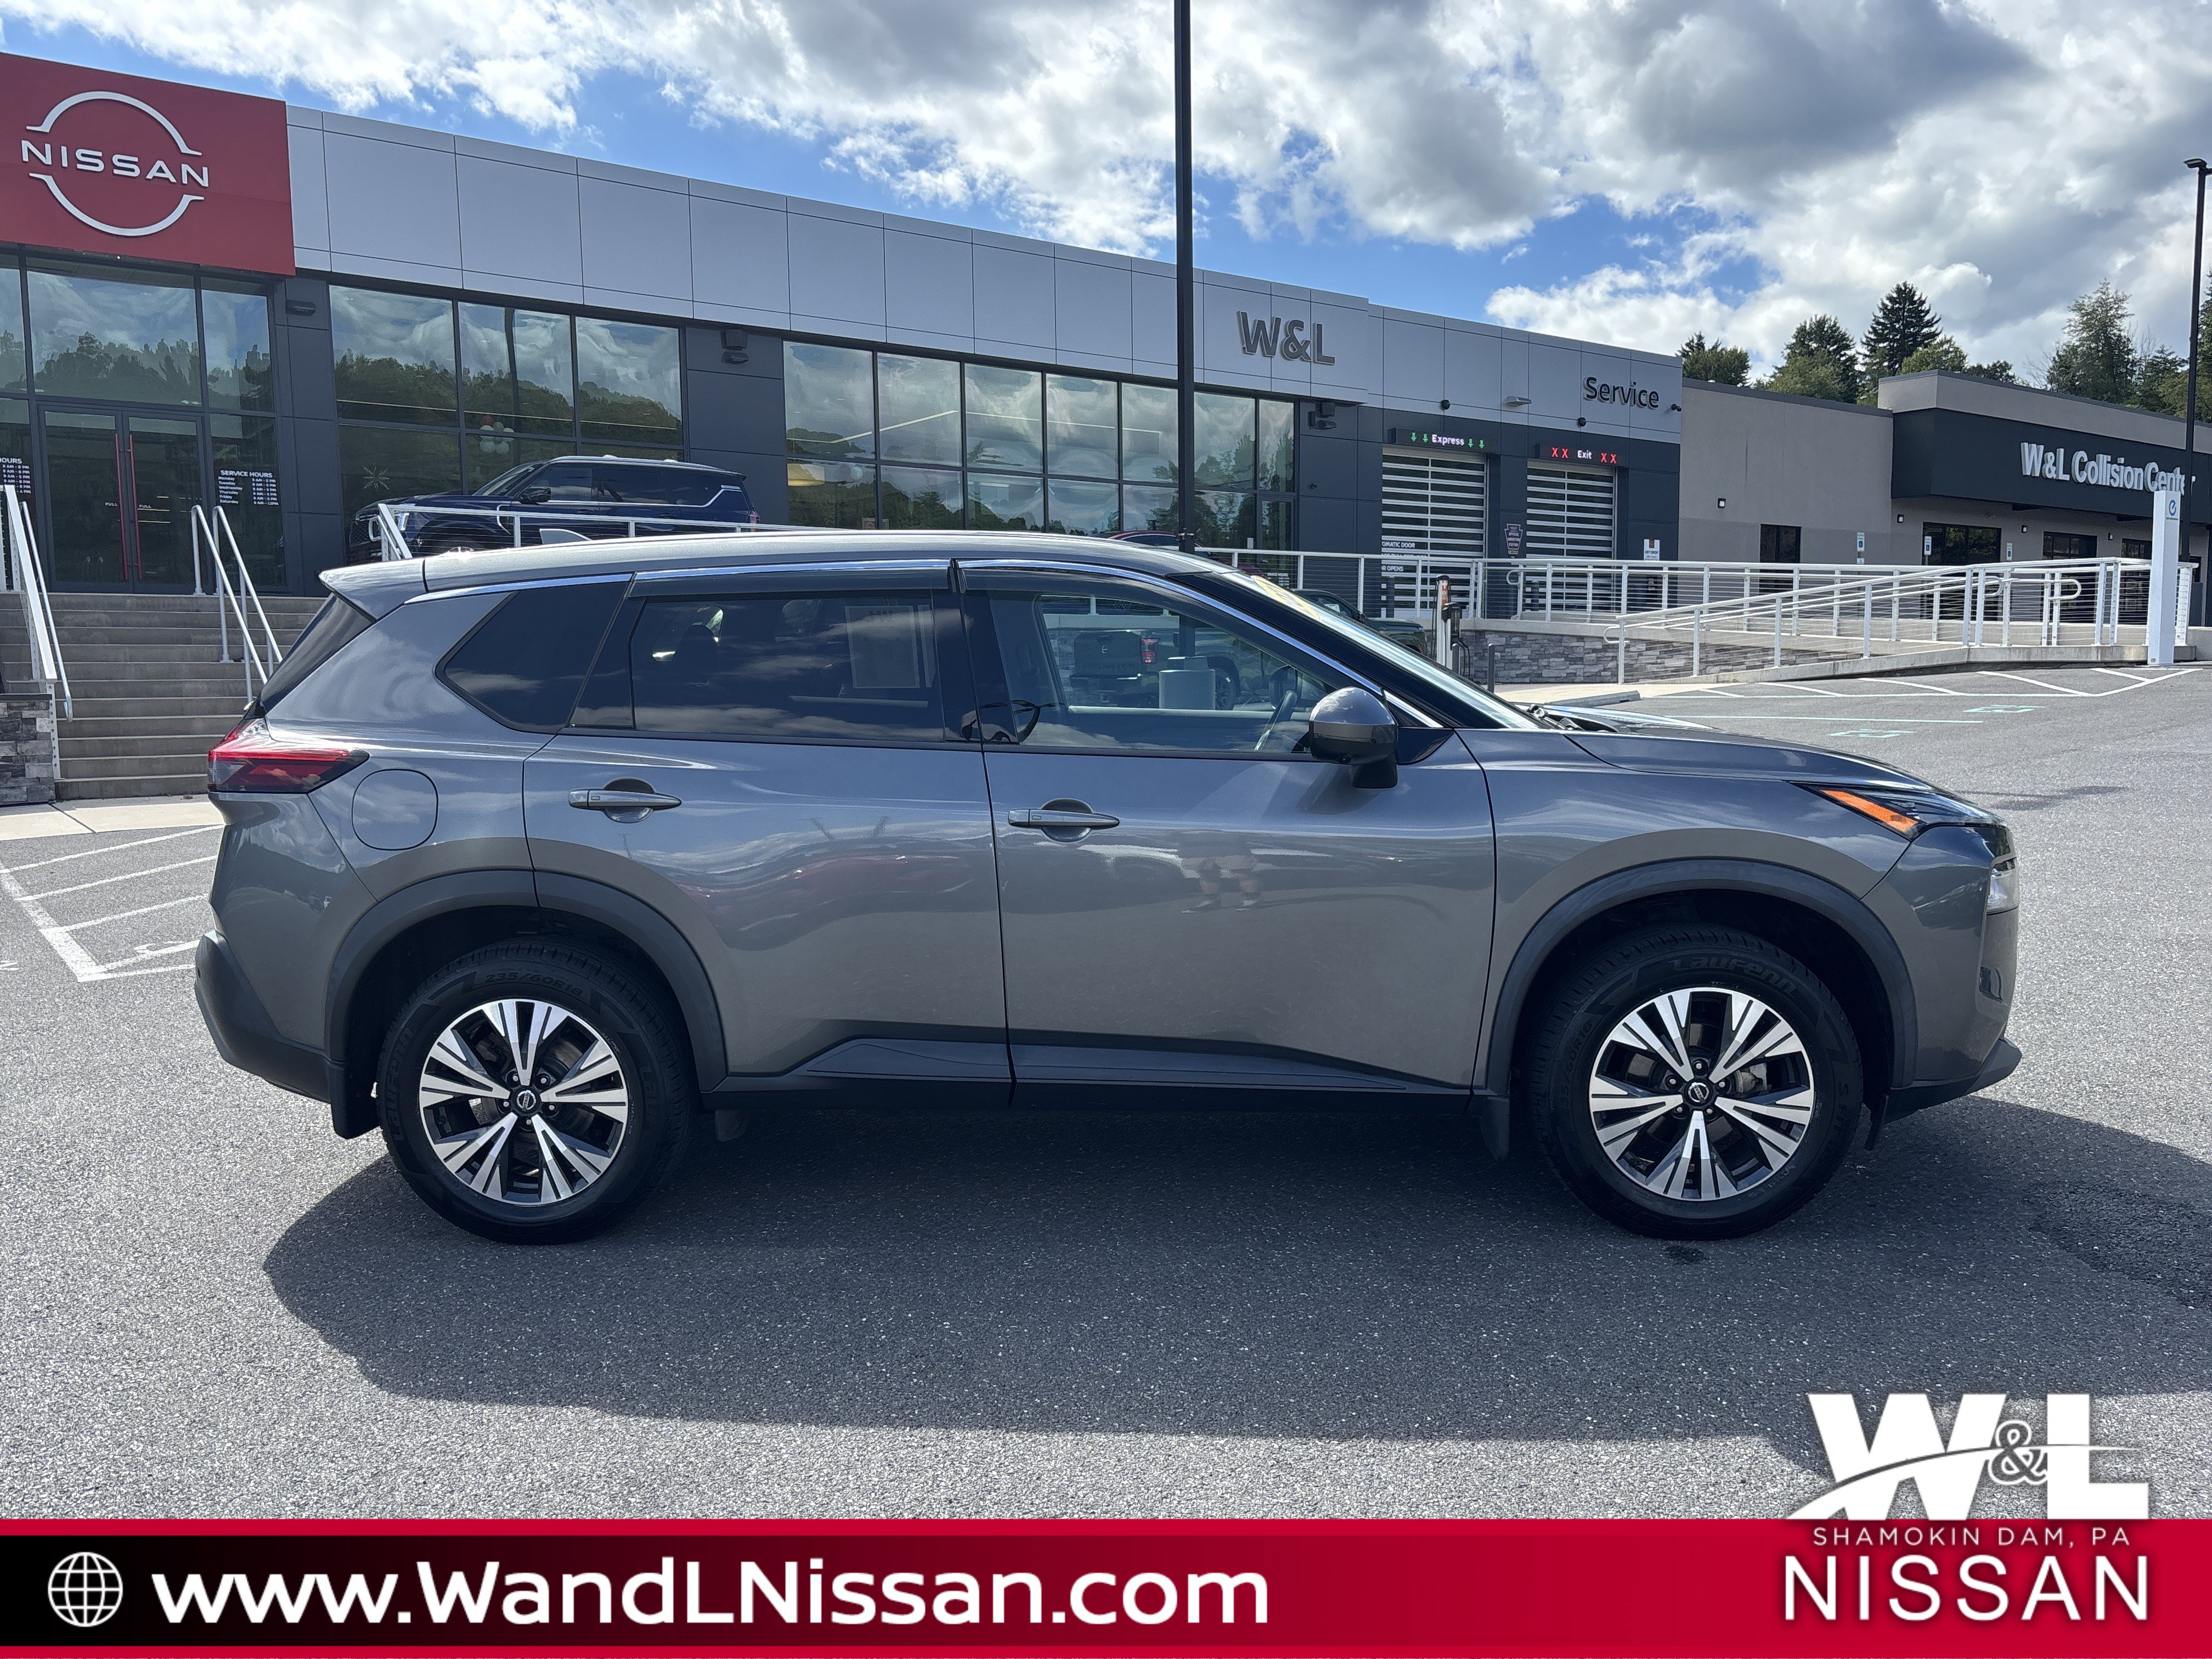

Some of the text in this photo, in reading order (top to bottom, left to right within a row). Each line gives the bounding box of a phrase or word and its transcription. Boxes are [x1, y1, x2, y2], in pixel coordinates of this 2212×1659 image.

[21, 140, 209, 188] NISSAN
[1236, 311, 1335, 365] W&L
[1583, 376, 1659, 409] Service
[1431, 434, 1464, 446] Express
[1577, 449, 1592, 460] Exit
[2021, 442, 2070, 481] W&L
[2072, 450, 2143, 490] Collision
[485, 972, 583, 996] 235/60R18
